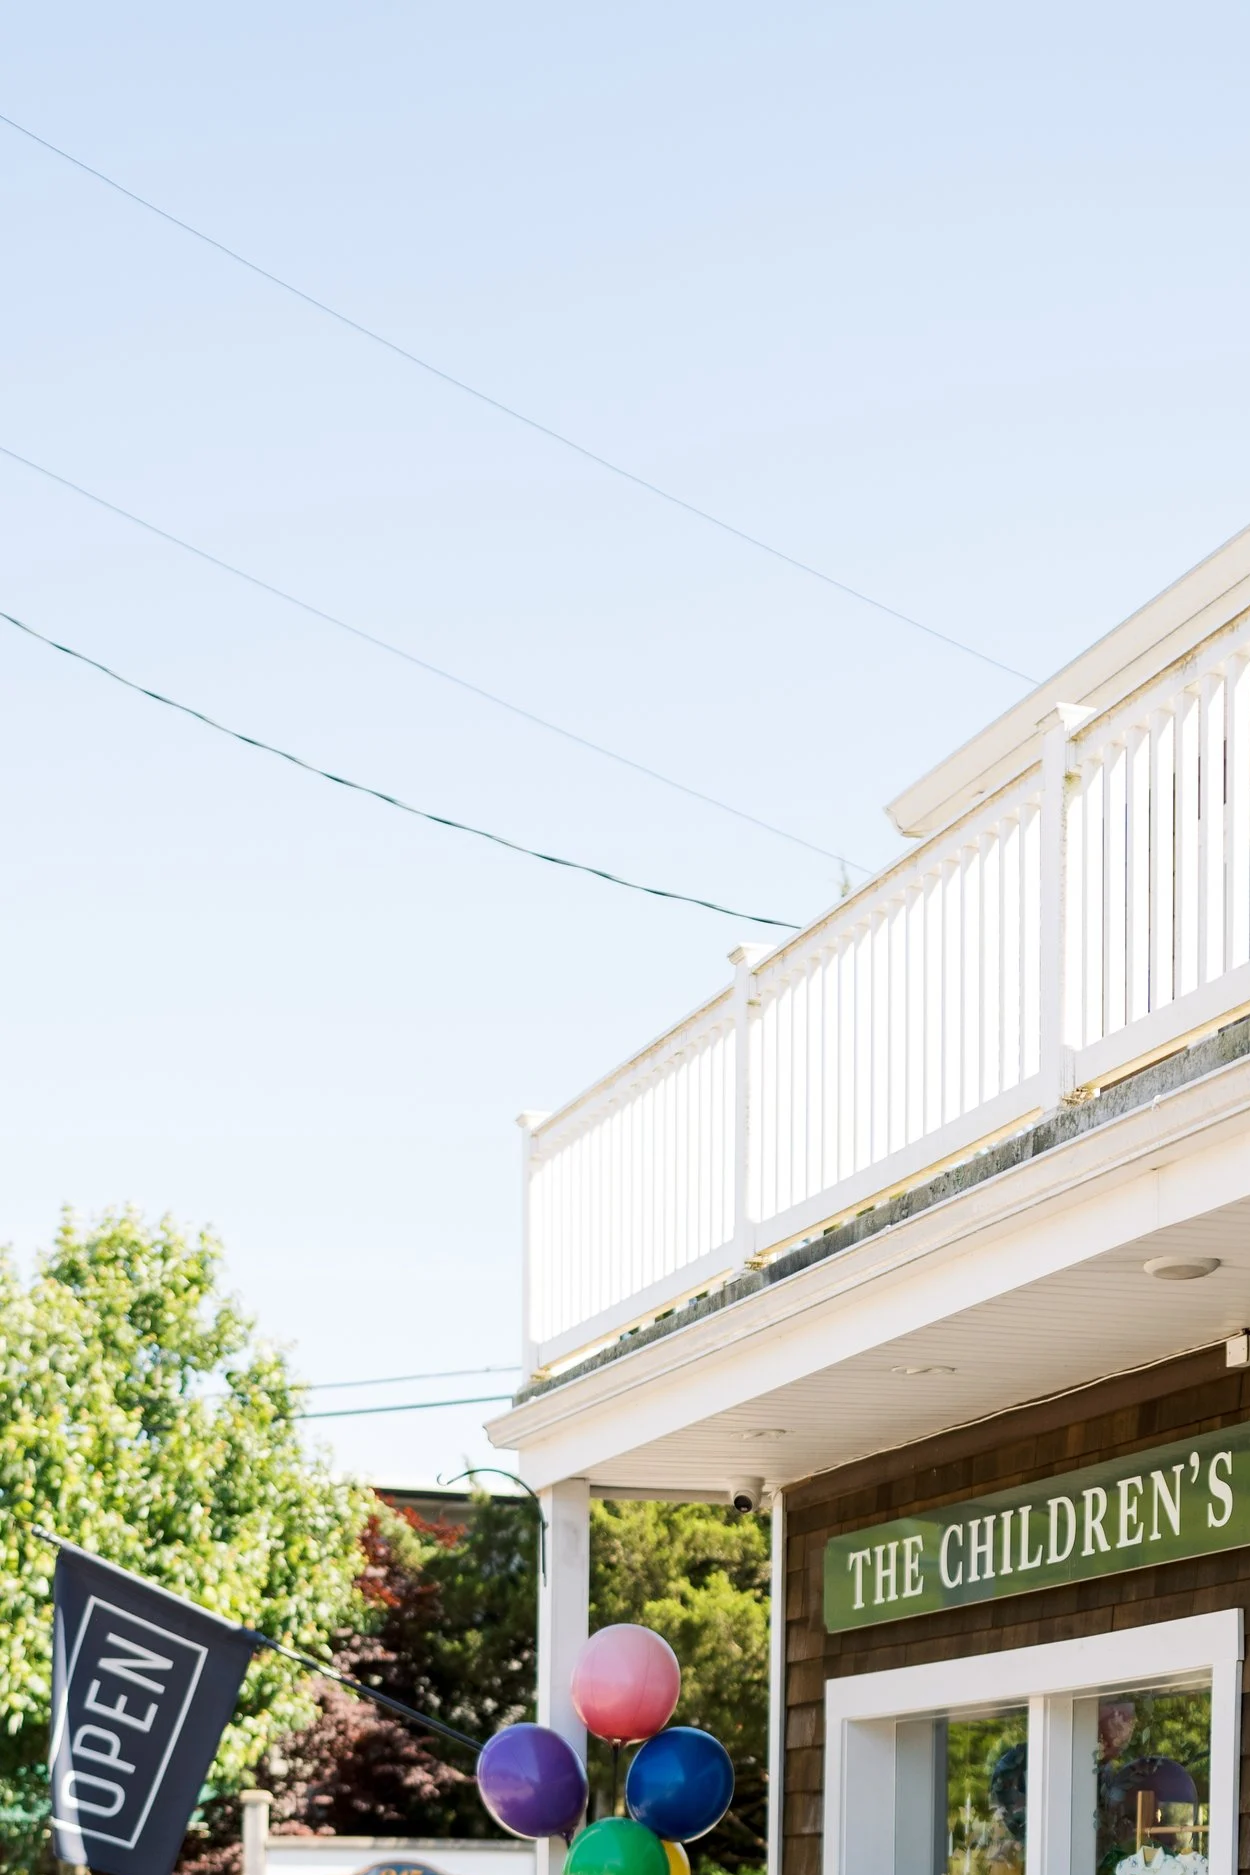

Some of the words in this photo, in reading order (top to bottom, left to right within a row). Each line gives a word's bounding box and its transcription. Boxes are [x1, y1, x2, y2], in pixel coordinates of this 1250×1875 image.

[847, 1534, 925, 1610] THE
[939, 1450, 1234, 1590] CHILDREN’S
[61, 1632, 174, 1818] OPEN
